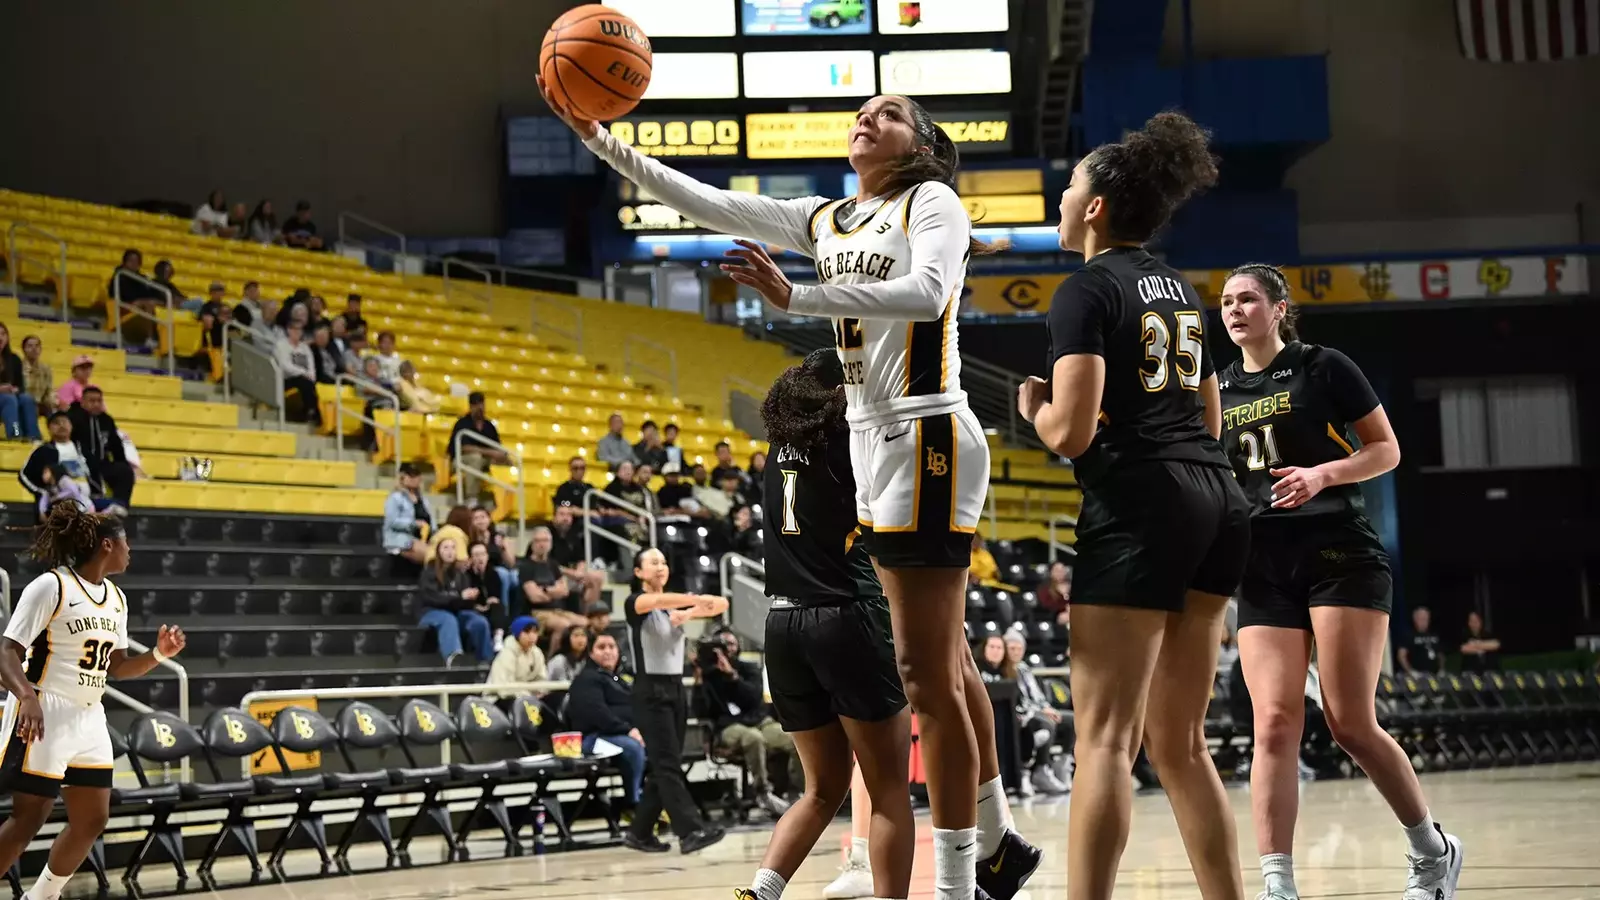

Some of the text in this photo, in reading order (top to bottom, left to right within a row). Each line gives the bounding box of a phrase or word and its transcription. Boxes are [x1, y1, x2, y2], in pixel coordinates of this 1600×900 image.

[837, 250, 896, 282] BEACH
[1137, 275, 1188, 305] CAULEY
[1138, 310, 1203, 392] 35
[1272, 368, 1293, 380] CAA
[1222, 391, 1292, 430] TRIBE
[1239, 423, 1283, 471] 21
[780, 468, 801, 535] 1
[65, 616, 98, 635] LONG
[78, 638, 114, 672] 30
